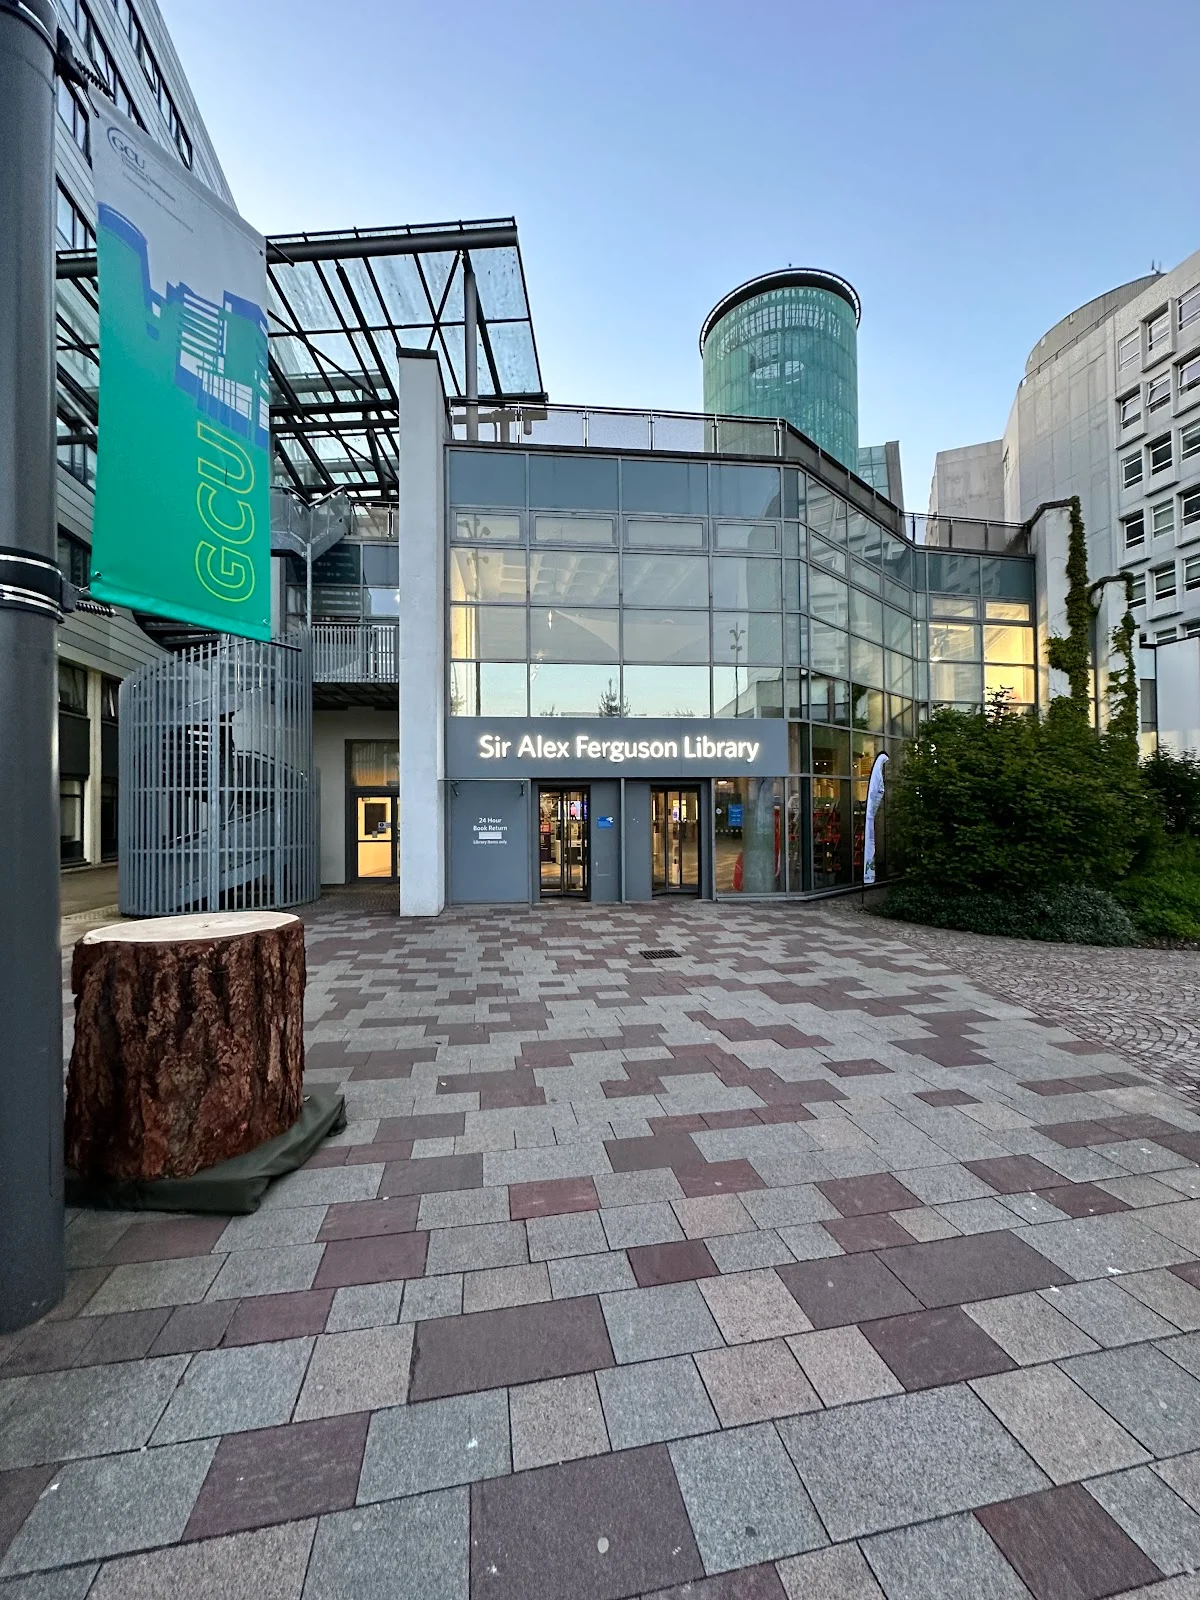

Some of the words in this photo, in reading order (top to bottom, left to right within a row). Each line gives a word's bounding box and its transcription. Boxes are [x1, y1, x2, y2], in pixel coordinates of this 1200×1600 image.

[112, 136, 145, 170] GCU
[195, 421, 256, 603] GCU
[479, 735, 511, 759] Sir
[517, 735, 570, 759] Alex
[575, 735, 678, 763] Ferguson
[684, 735, 760, 763] Library
